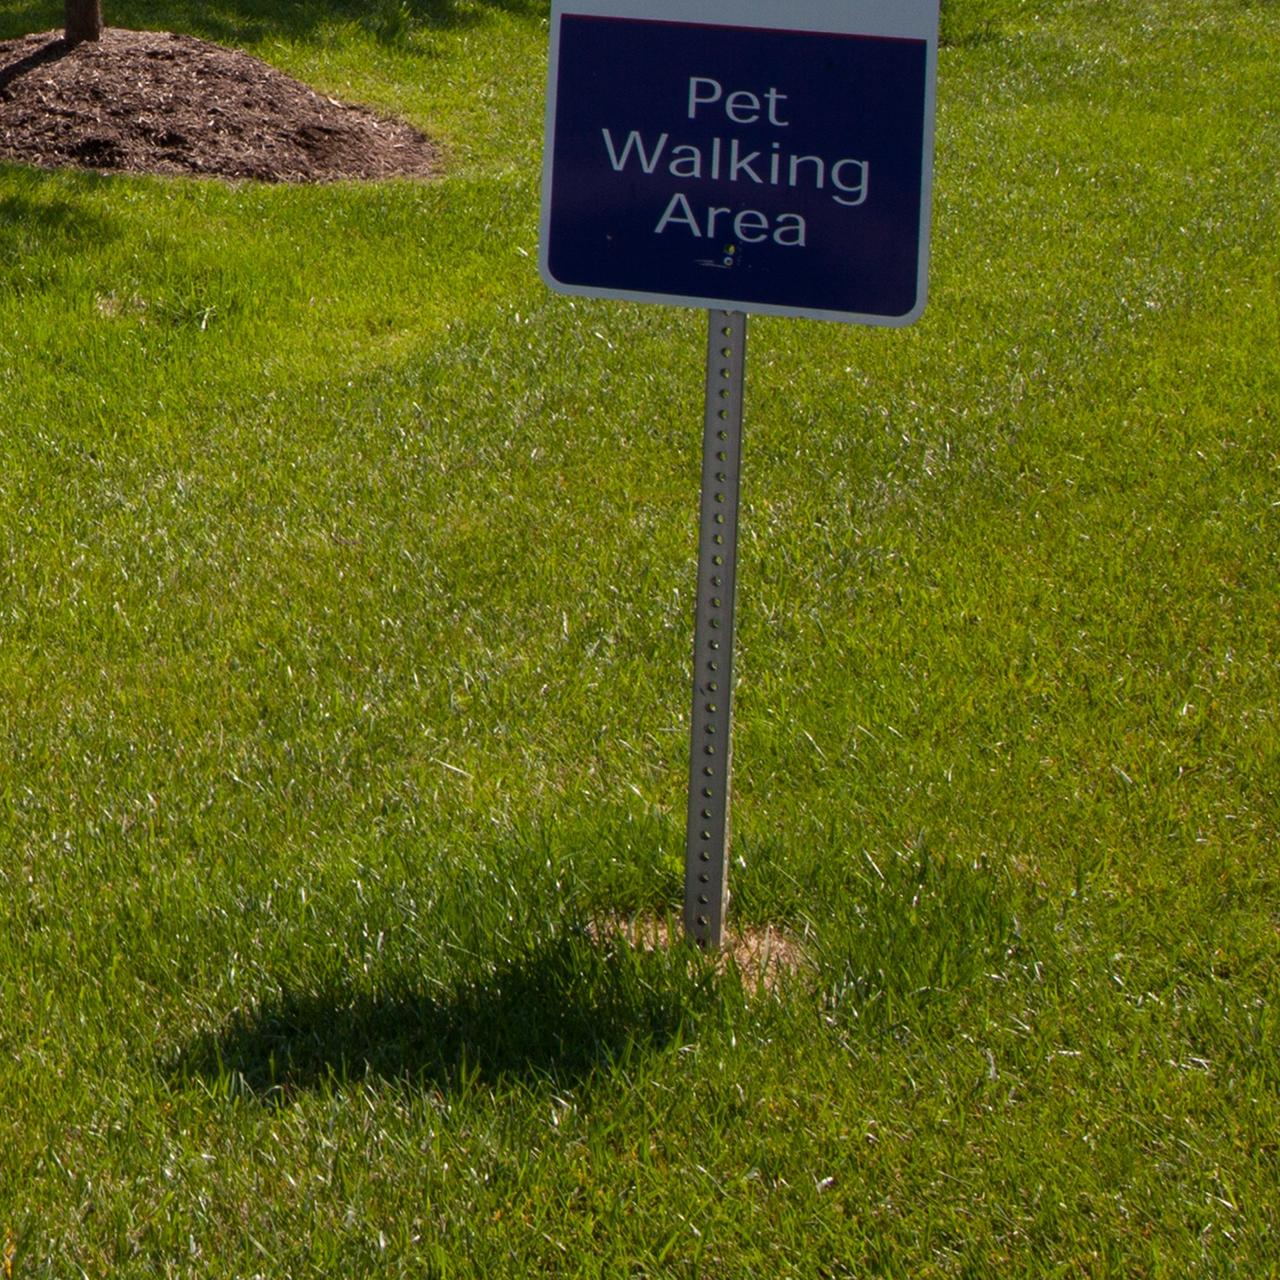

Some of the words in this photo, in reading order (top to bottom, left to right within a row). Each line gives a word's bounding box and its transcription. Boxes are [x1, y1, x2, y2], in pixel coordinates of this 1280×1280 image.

[687, 76, 789, 127] Pet
[601, 128, 870, 206] Walking
[653, 192, 807, 247] Area
